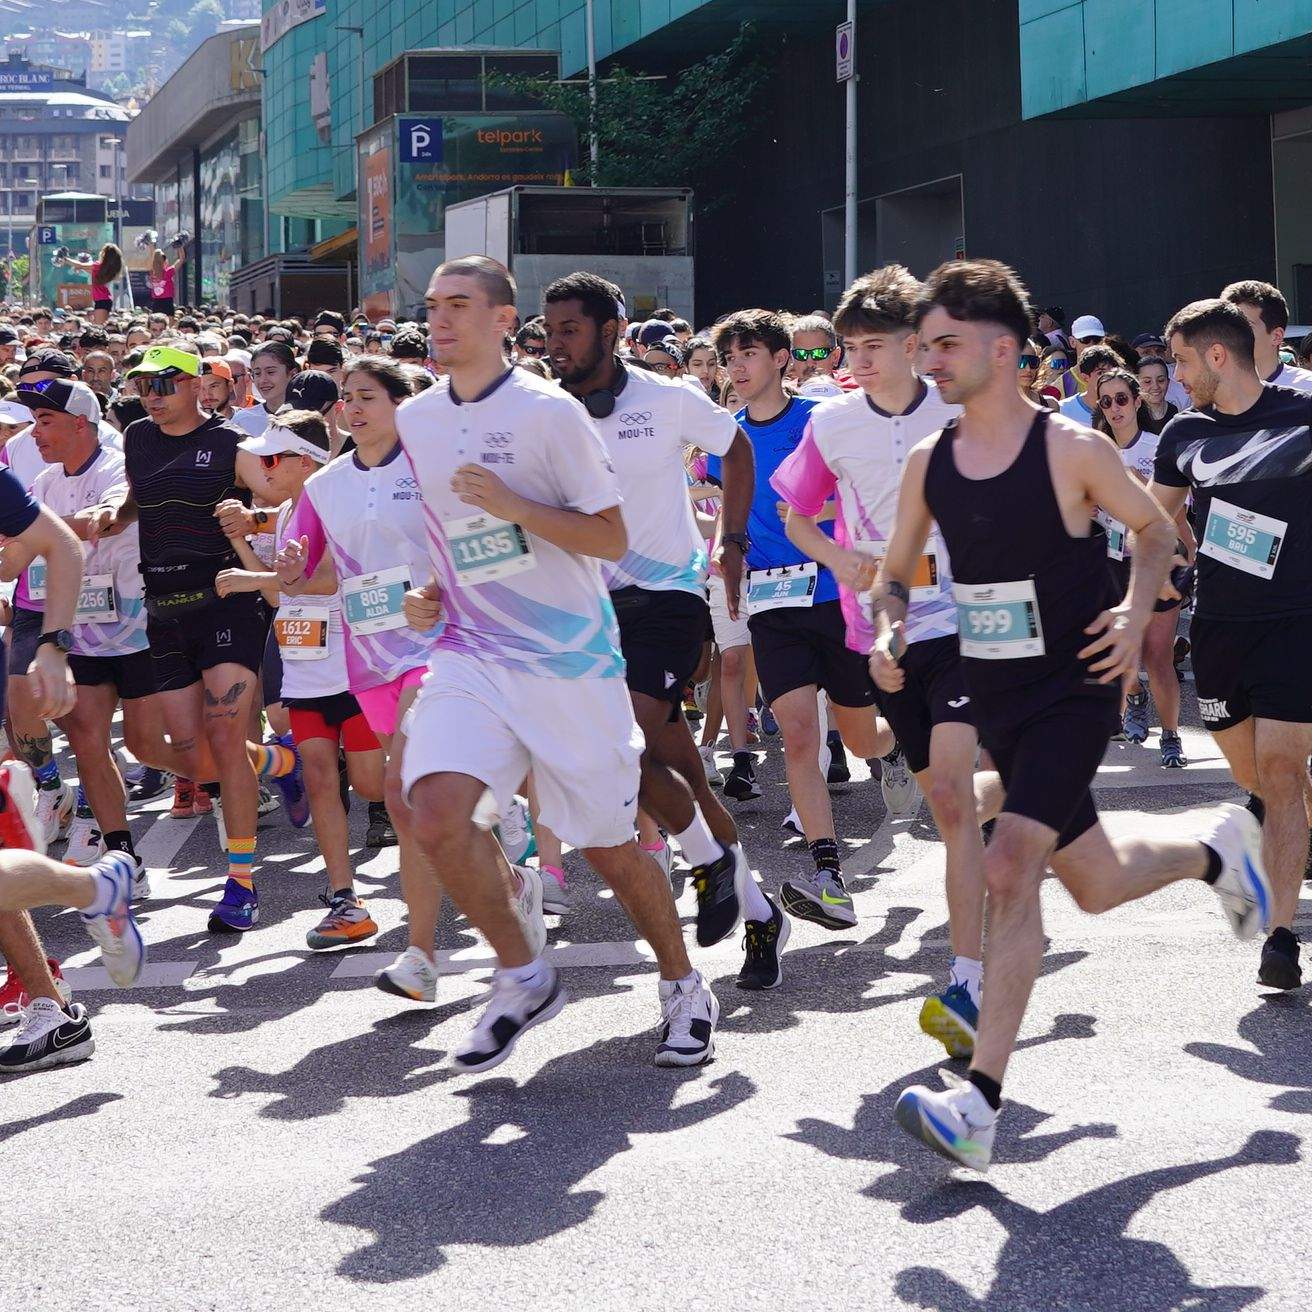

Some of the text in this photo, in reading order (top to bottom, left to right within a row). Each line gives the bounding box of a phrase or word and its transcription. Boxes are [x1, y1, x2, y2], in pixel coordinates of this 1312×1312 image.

[0, 74, 18, 84] ROC
[19, 74, 50, 84] BLANC
[476, 128, 544, 146] telpark
[411, 131, 431, 158] P
[617, 427, 656, 440] MOU-TE
[480, 452, 516, 465] MOU-TE
[1226, 522, 1258, 546] 595
[457, 531, 515, 564] 1135
[773, 580, 792, 593] 45
[359, 587, 388, 607] 805
[365, 605, 390, 618] ALDA
[281, 621, 311, 635] 1612
[968, 608, 1013, 635] 999
[285, 634, 303, 645] ERIC
